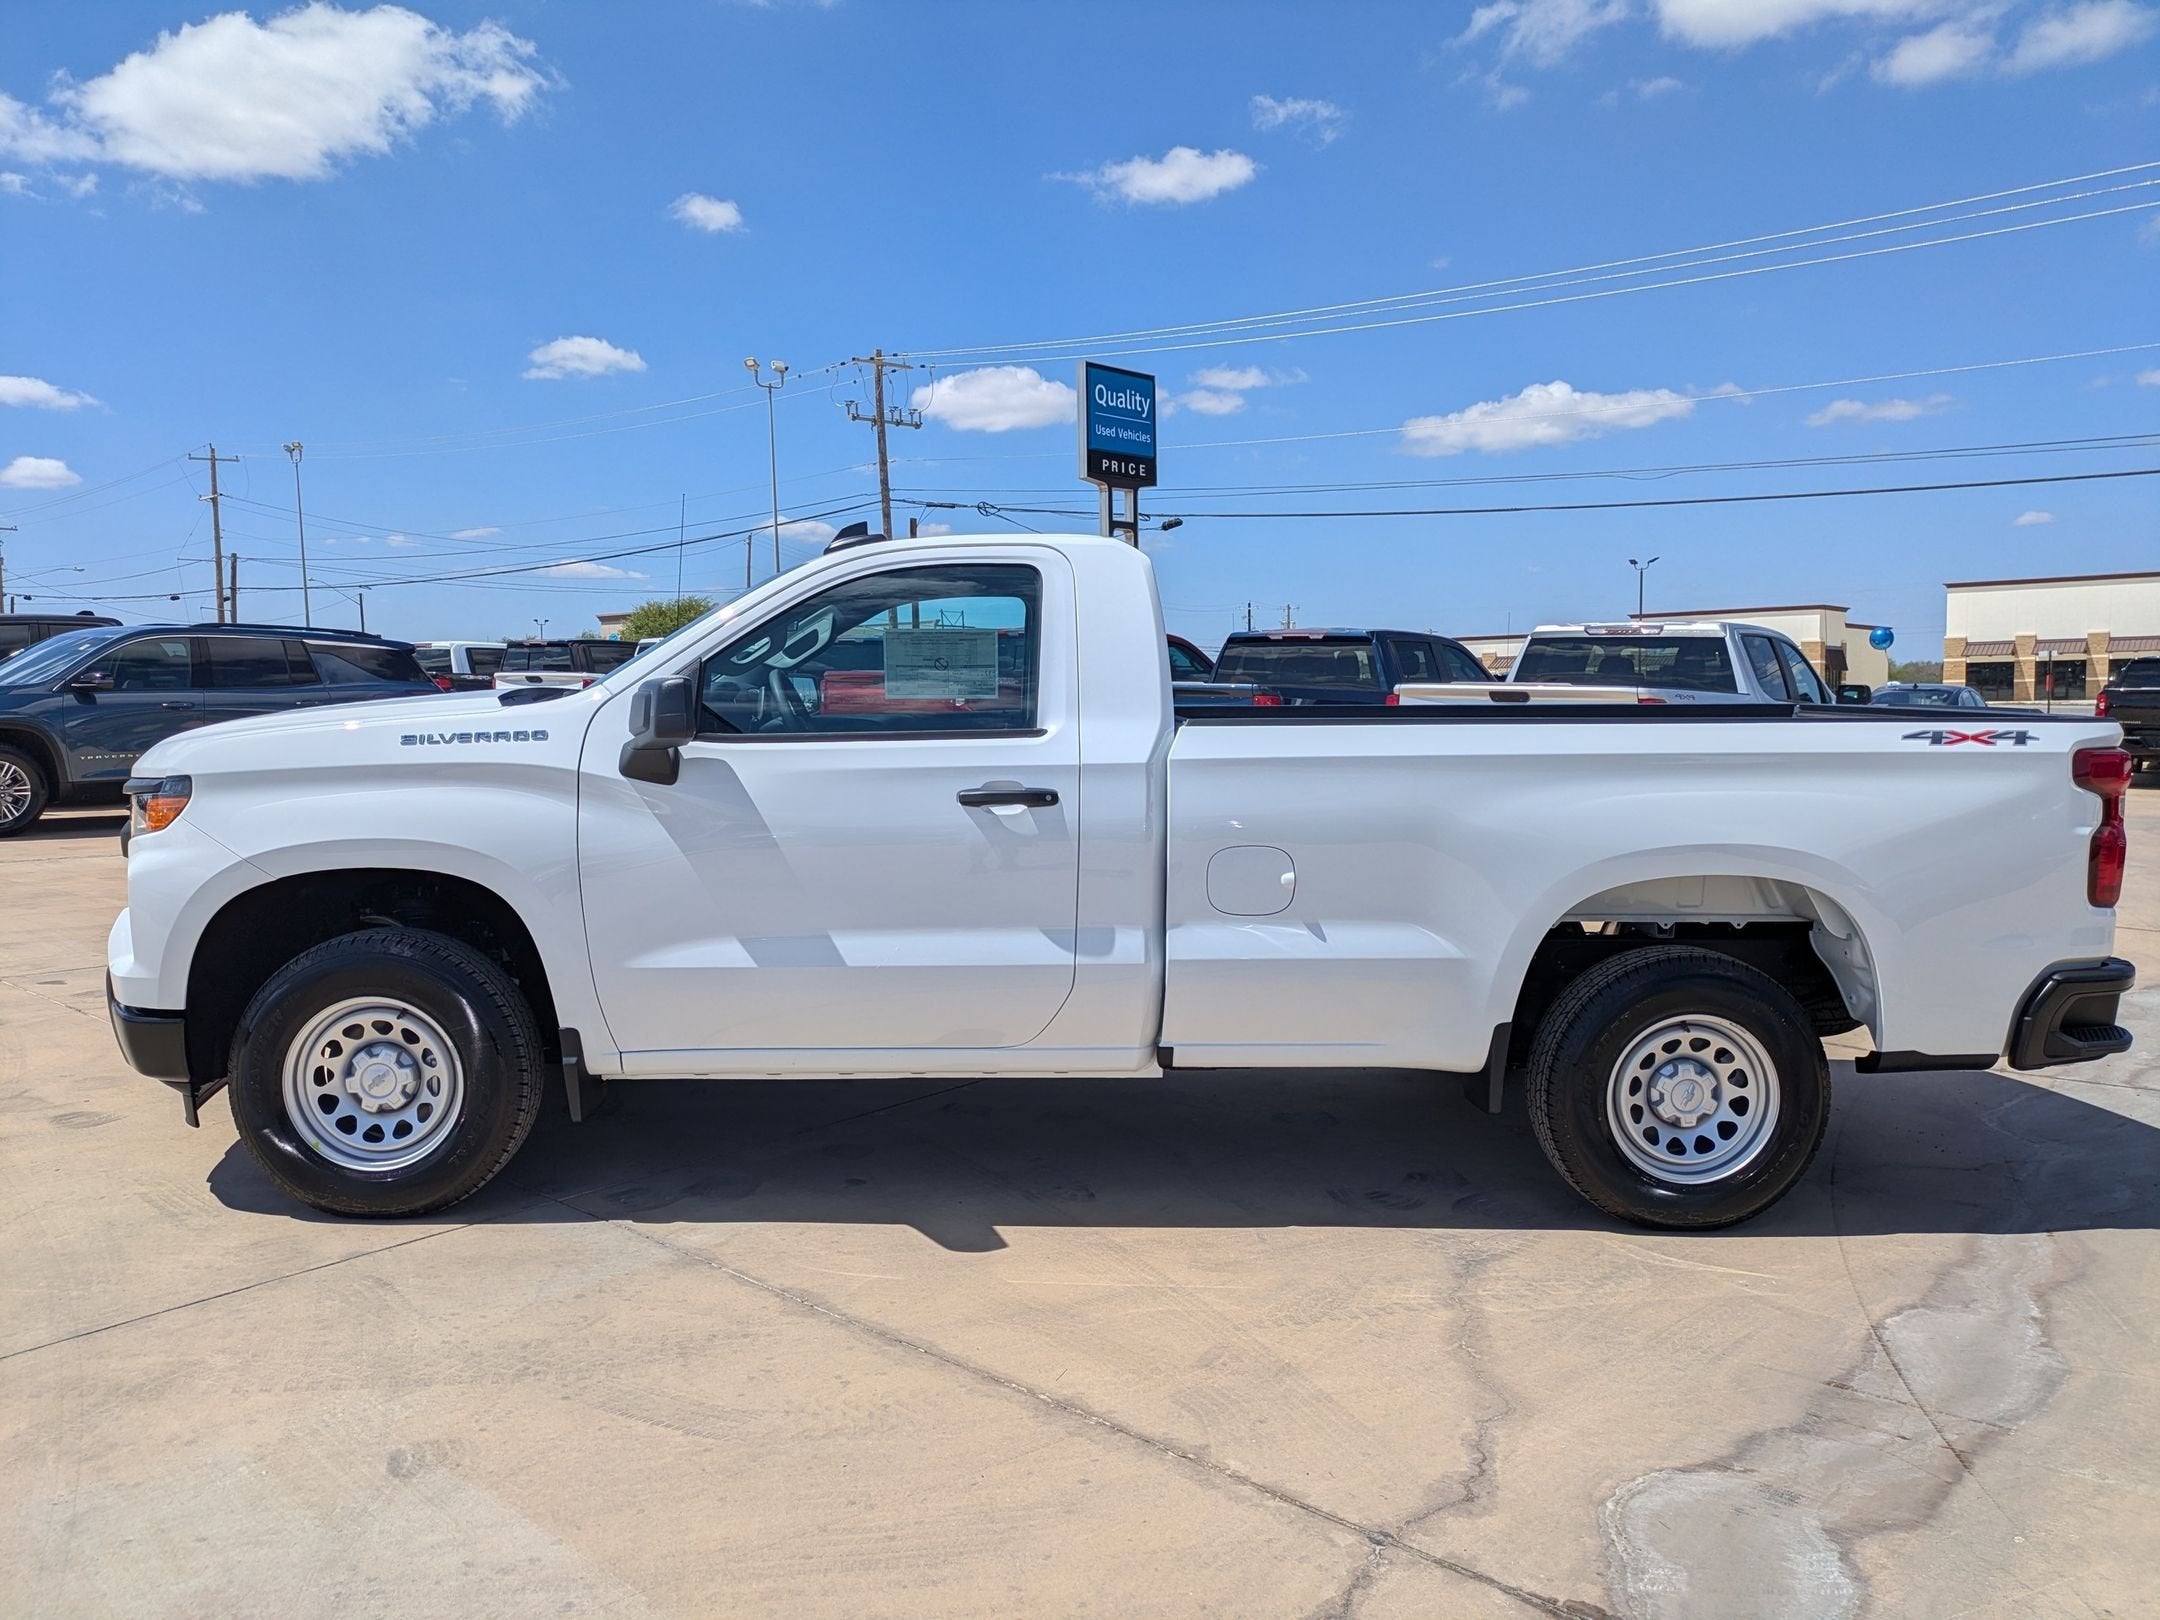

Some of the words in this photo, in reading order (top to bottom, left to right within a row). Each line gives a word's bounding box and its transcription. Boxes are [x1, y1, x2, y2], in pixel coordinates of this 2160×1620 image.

[1095, 384, 1150, 418] Quality
[1095, 424, 1116, 437] Used
[1118, 428, 1151, 443] Vehicles
[1102, 459, 1147, 476] PRICE
[400, 729, 549, 746] SILVERADO
